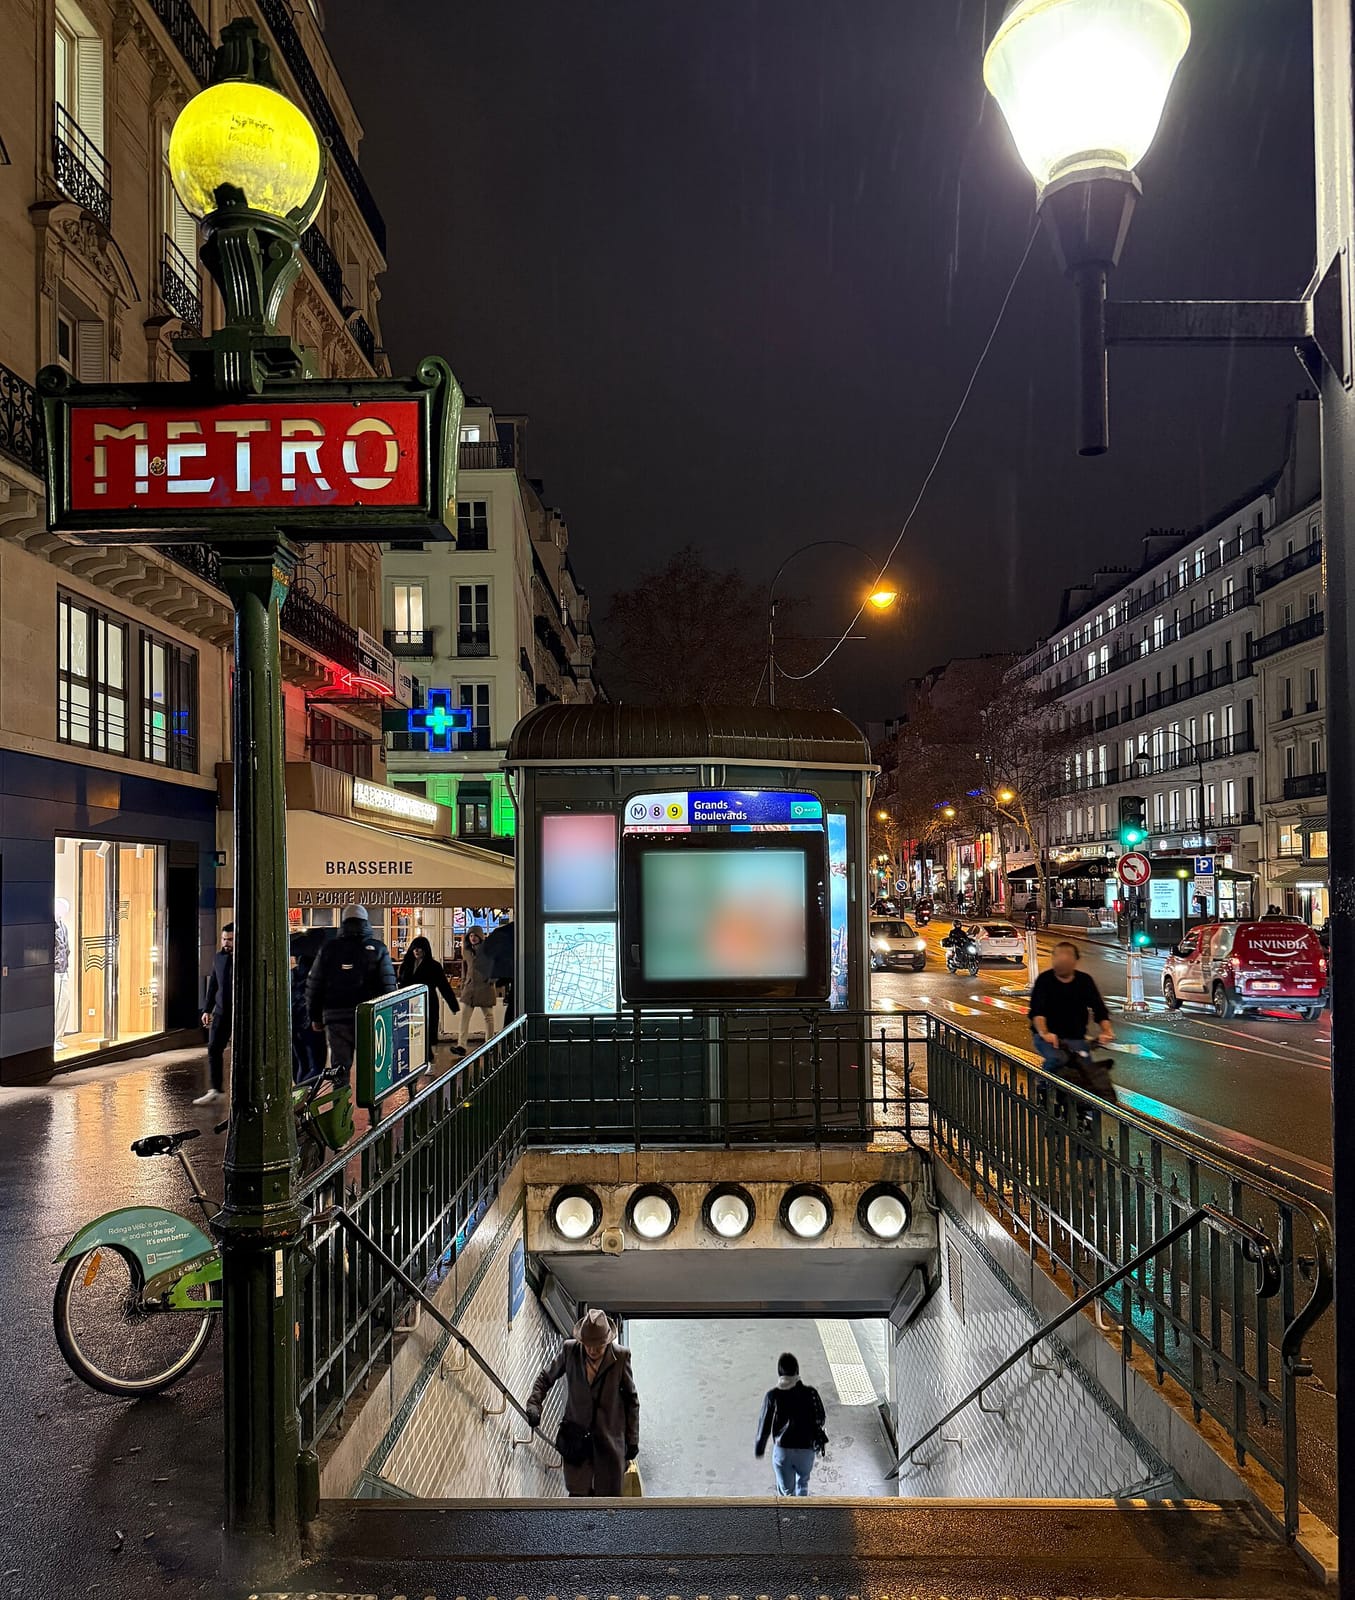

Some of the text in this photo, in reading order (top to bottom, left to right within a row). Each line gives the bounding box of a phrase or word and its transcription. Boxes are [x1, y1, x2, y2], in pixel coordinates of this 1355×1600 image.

[93, 417, 399, 494] METRO
[653, 806, 661, 816] 8
[671, 806, 678, 816] 9
[693, 800, 729, 811] Grands
[694, 811, 748, 821] Boulevards
[325, 861, 414, 875] BRASSERIE
[1199, 859, 1209, 872] P
[297, 890, 443, 906] LA PORTE MONTMARTRE
[1248, 939, 1309, 950] INVINDIA
[108, 1226, 128, 1236] Riding
[129, 1232, 140, 1240] and
[140, 1230, 153, 1238] with
[152, 1228, 163, 1236] the
[156, 1235, 171, 1243] even
